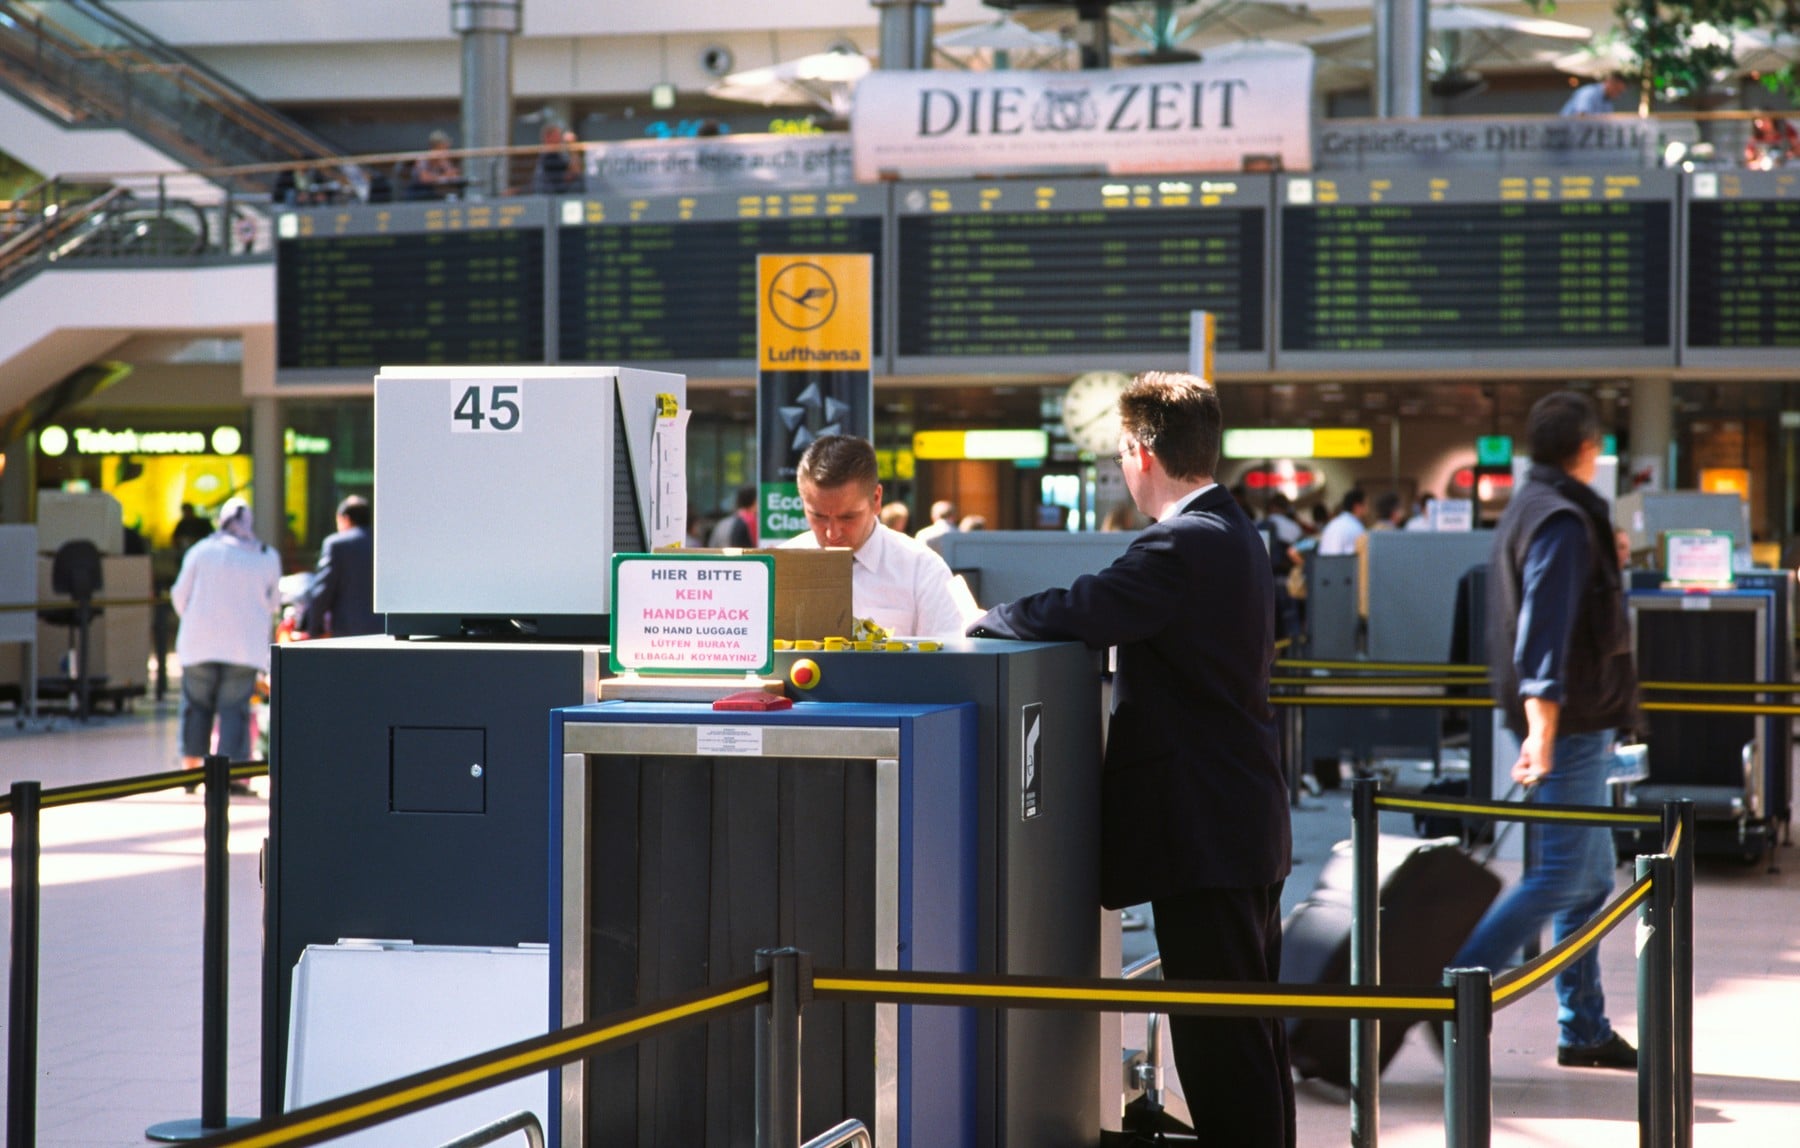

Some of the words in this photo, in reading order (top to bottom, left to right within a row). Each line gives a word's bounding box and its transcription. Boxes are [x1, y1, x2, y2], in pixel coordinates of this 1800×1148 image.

[917, 87, 1025, 137] DIE
[1106, 78, 1248, 132] ZEIT
[1485, 125, 1537, 150] DIE
[768, 346, 861, 362] Lufthansa
[453, 385, 520, 431] 45
[767, 492, 804, 510] Eco
[767, 513, 809, 531] Clas
[651, 569, 688, 581] HIER
[697, 569, 742, 581] BITTE
[675, 589, 713, 600] KEIN
[643, 607, 749, 621] HANDGEPÄCK
[644, 625, 660, 635] NO
[663, 626, 693, 636] HAND
[696, 626, 748, 636] LUGGAGE
[697, 639, 740, 649] BURAYA
